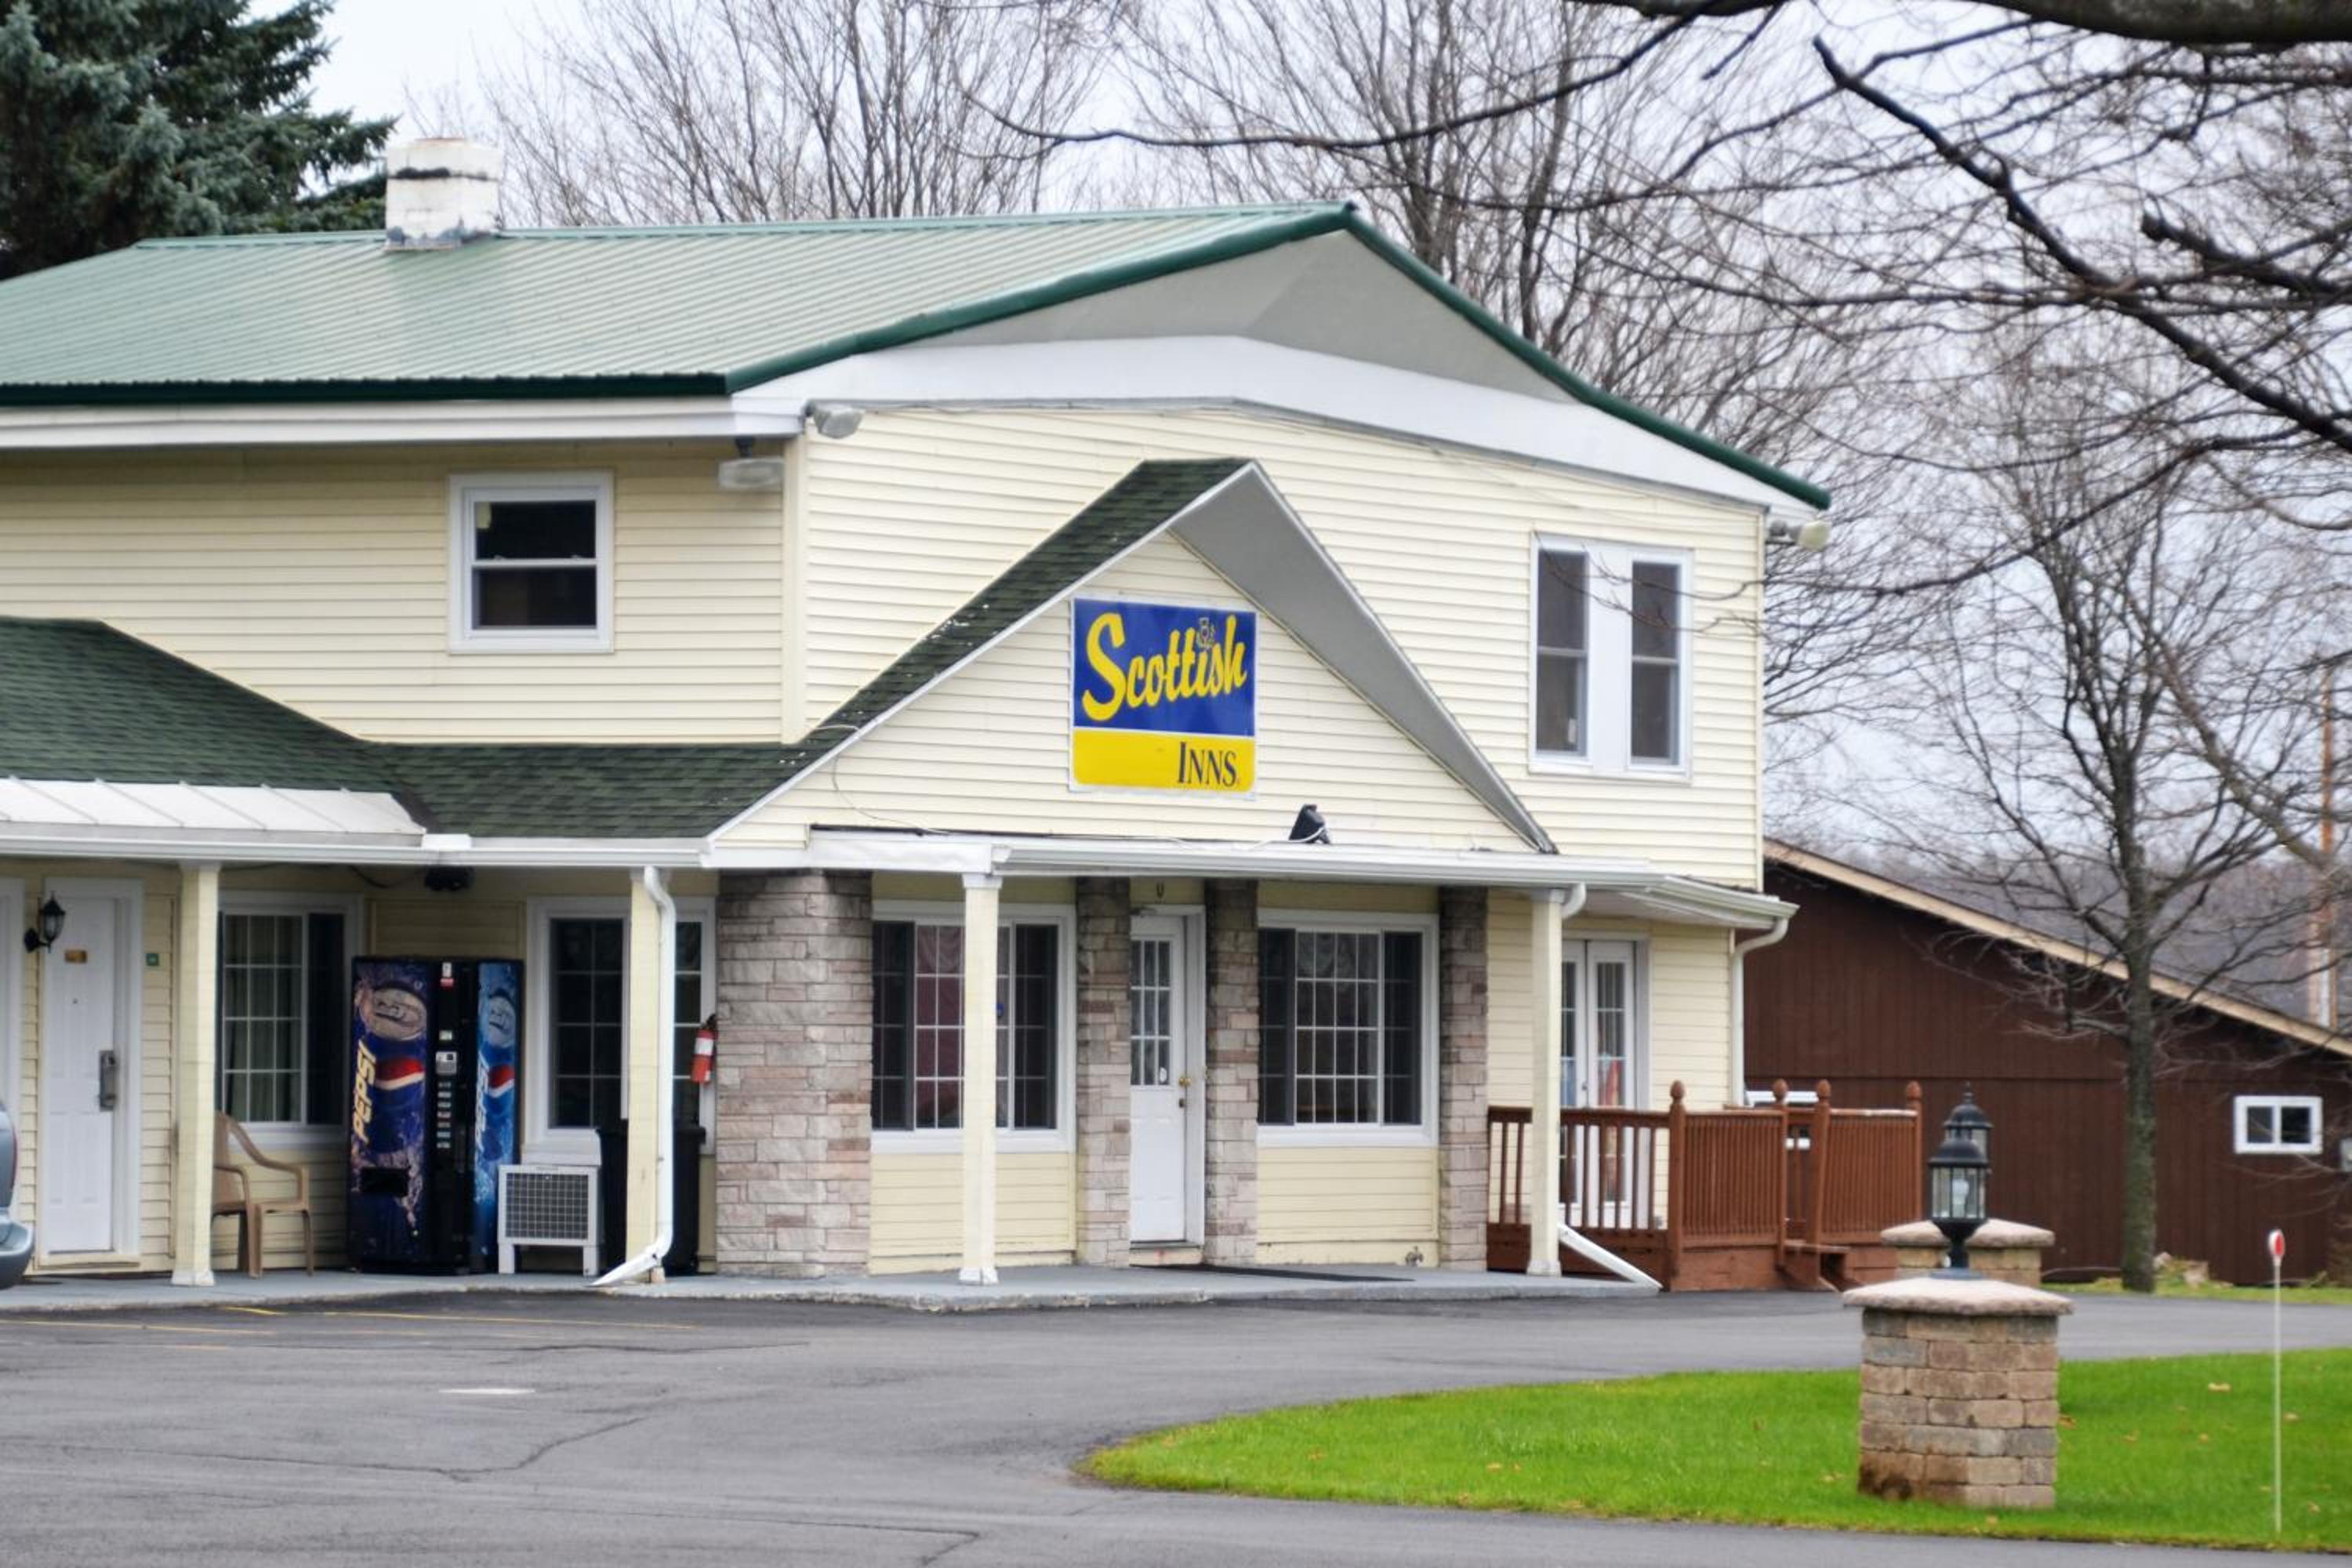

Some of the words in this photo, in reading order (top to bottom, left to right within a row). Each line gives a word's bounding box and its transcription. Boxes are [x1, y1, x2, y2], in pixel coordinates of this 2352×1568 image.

[1082, 612, 1247, 721] Scottish
[1178, 741, 1238, 787] INNS
[353, 1039, 376, 1144] PEPSI
